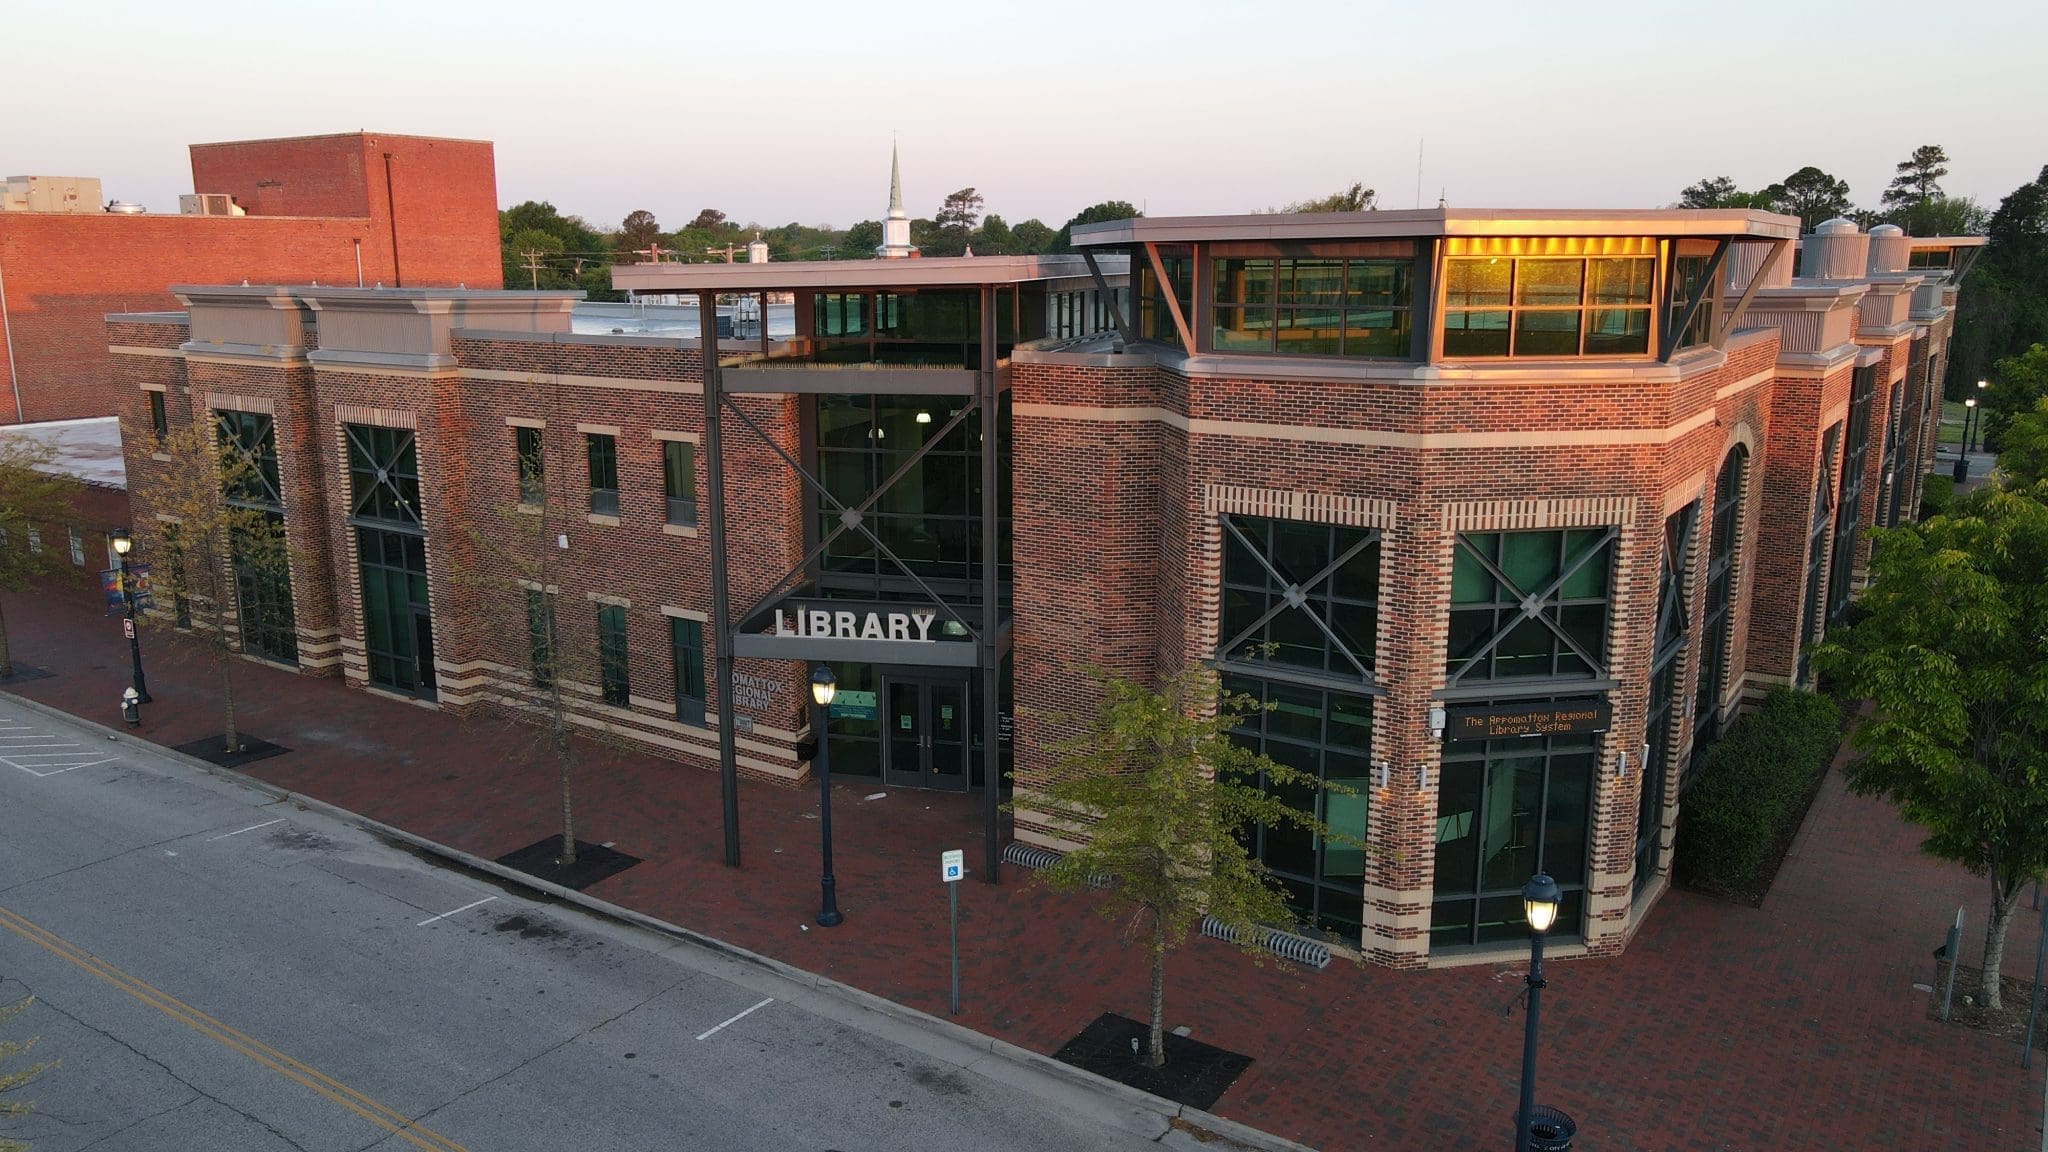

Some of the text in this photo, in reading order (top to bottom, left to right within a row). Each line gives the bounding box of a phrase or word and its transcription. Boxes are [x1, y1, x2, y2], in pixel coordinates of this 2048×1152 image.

[775, 607, 936, 642] LIBRARY
[714, 671, 782, 693] OMATTOX
[732, 684, 772, 701] GIONAL
[732, 694, 769, 711] IBRARY
[1464, 709, 1598, 727] The Appomattox Regional
[1489, 721, 1572, 735] Library System
